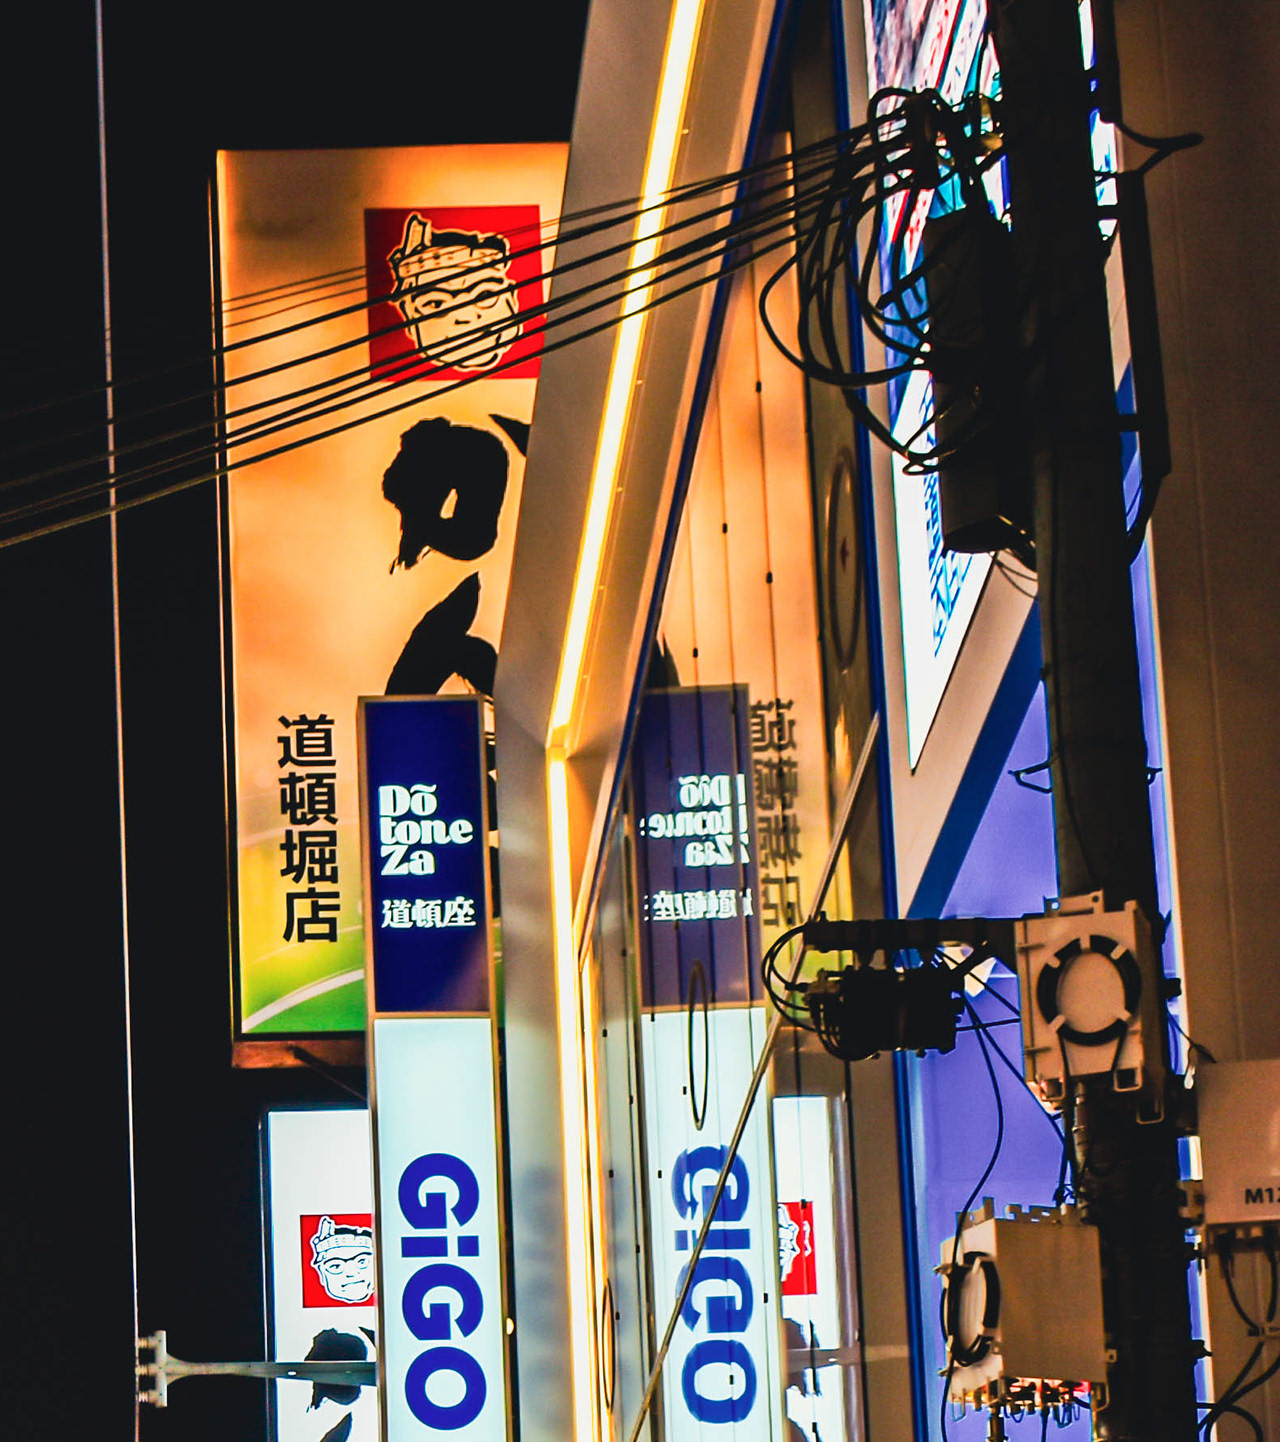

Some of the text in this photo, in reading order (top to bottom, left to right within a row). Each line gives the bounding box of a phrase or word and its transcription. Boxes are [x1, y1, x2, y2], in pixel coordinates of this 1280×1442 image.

[277, 714, 341, 943] 道頓堀店
[379, 816, 474, 847] tone
[379, 845, 437, 876] Za
[381, 896, 477, 929] 道頓座
